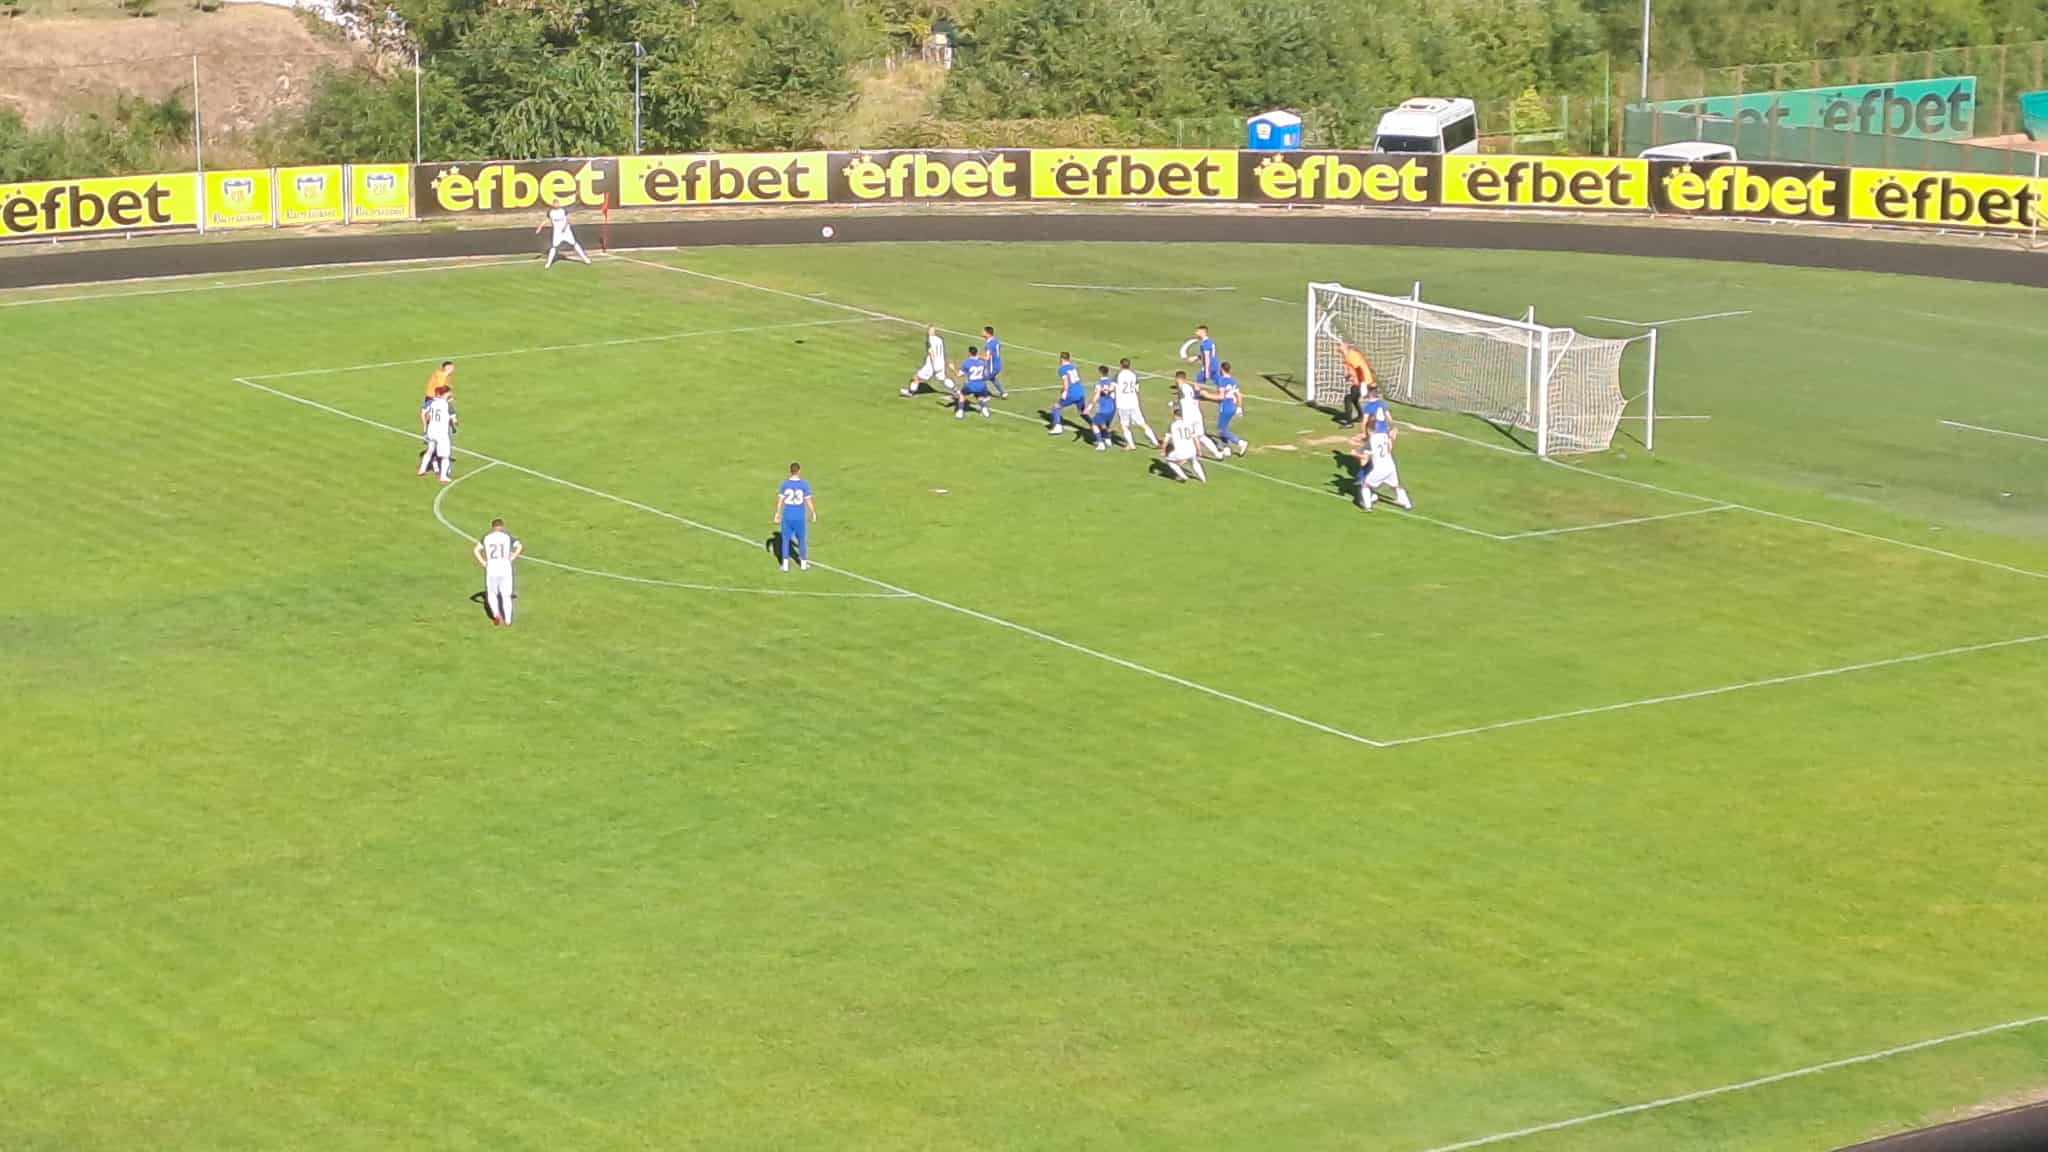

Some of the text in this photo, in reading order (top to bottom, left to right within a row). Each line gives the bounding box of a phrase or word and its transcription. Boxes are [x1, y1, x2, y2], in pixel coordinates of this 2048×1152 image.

[437, 160, 604, 211] efbet
[644, 159, 809, 202] efbet
[848, 153, 1016, 199] efbet
[1055, 155, 1220, 196] efbet
[1259, 155, 1428, 201] efbet
[1466, 161, 1633, 205] efbet
[1668, 166, 1836, 216] efbet
[2, 181, 171, 232] efbet
[1875, 177, 2041, 227] efbet
[969, 365, 984, 380] 22
[784, 488, 804, 505] 23
[490, 543, 504, 559] 21
